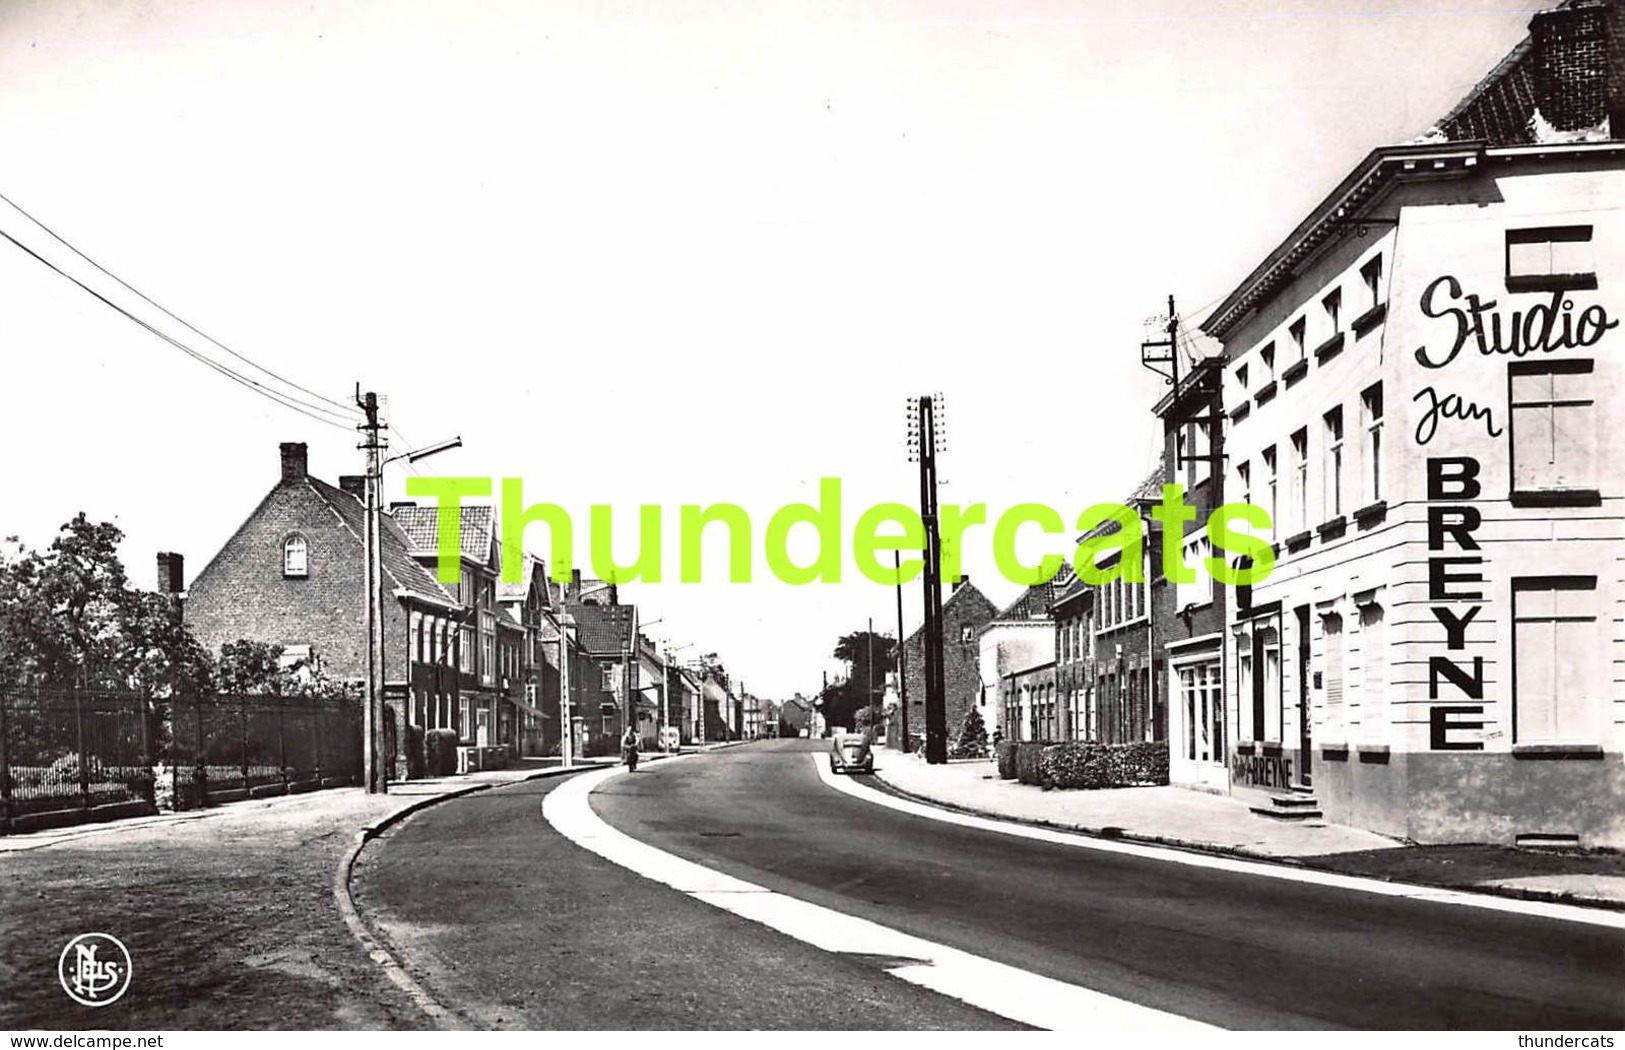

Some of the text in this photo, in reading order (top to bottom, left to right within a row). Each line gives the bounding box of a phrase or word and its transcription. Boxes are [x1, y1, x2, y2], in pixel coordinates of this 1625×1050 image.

[1415, 275, 1619, 368] Studio
[1427, 457, 1484, 750] BREYNE
[1252, 757, 1293, 789] BREYNE
